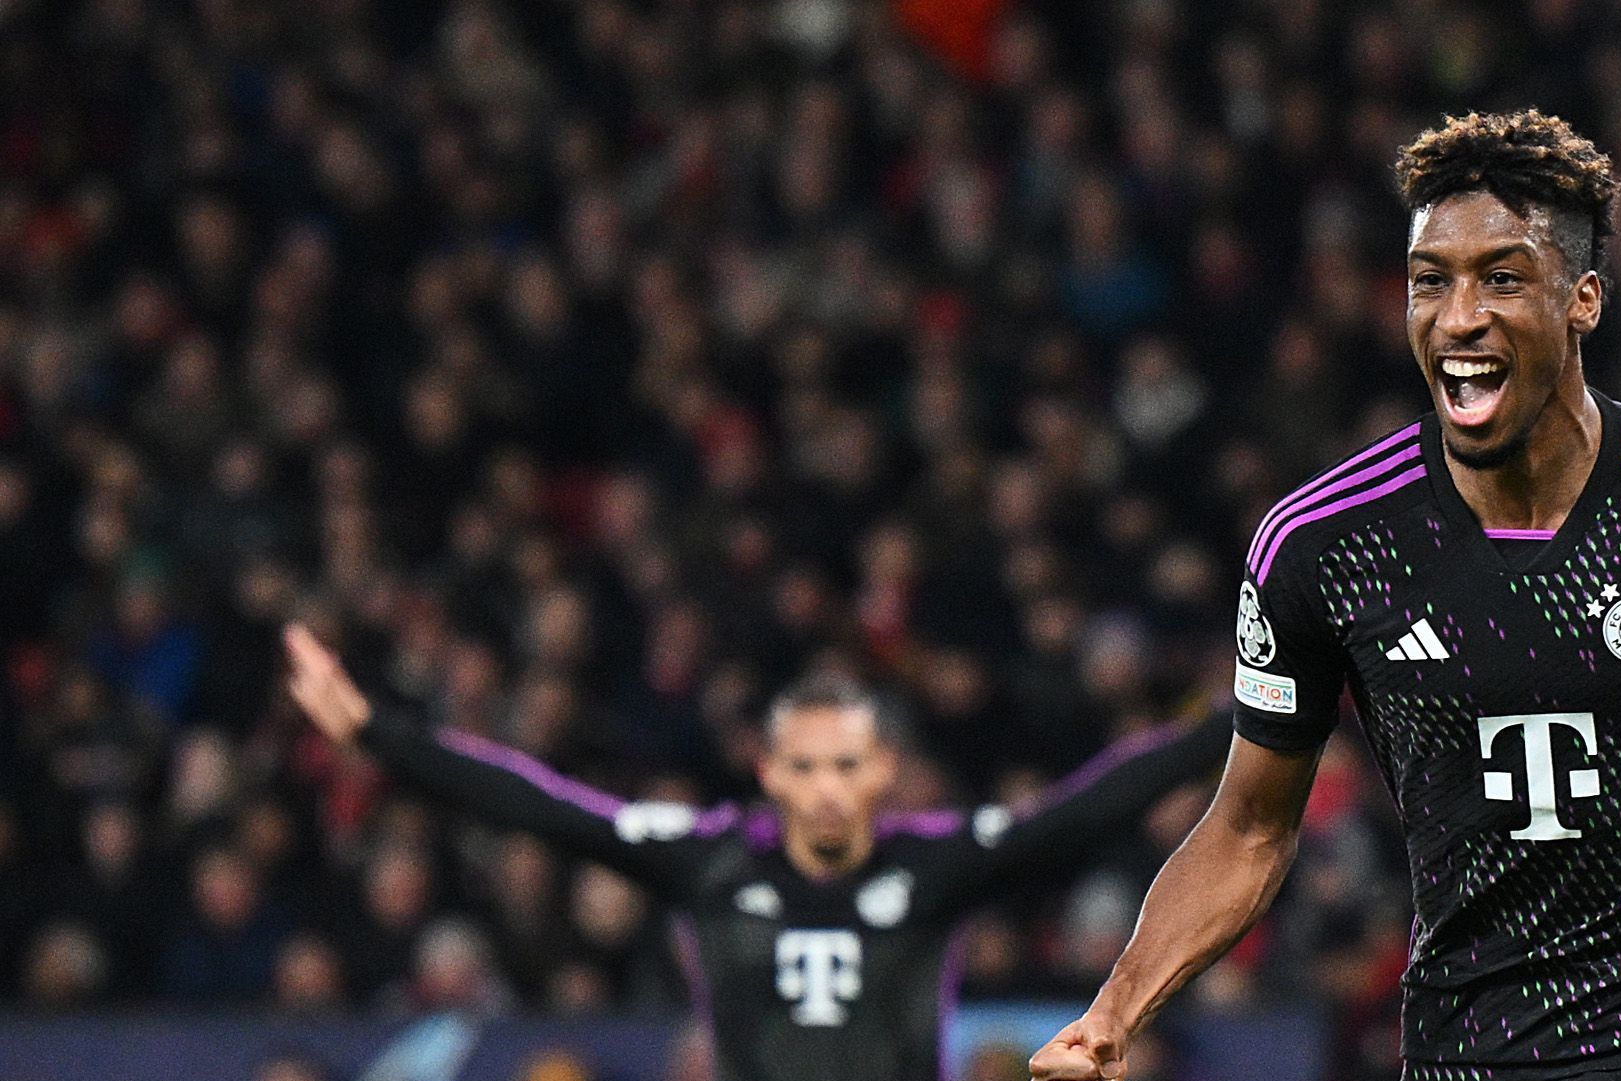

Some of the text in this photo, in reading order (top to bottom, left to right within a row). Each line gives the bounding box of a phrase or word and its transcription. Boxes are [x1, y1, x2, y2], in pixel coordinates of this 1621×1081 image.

[1609, 613, 1621, 628] FC
[1238, 678, 1293, 702] NDATION
[1477, 712, 1600, 841] T
[775, 929, 863, 1027] T
